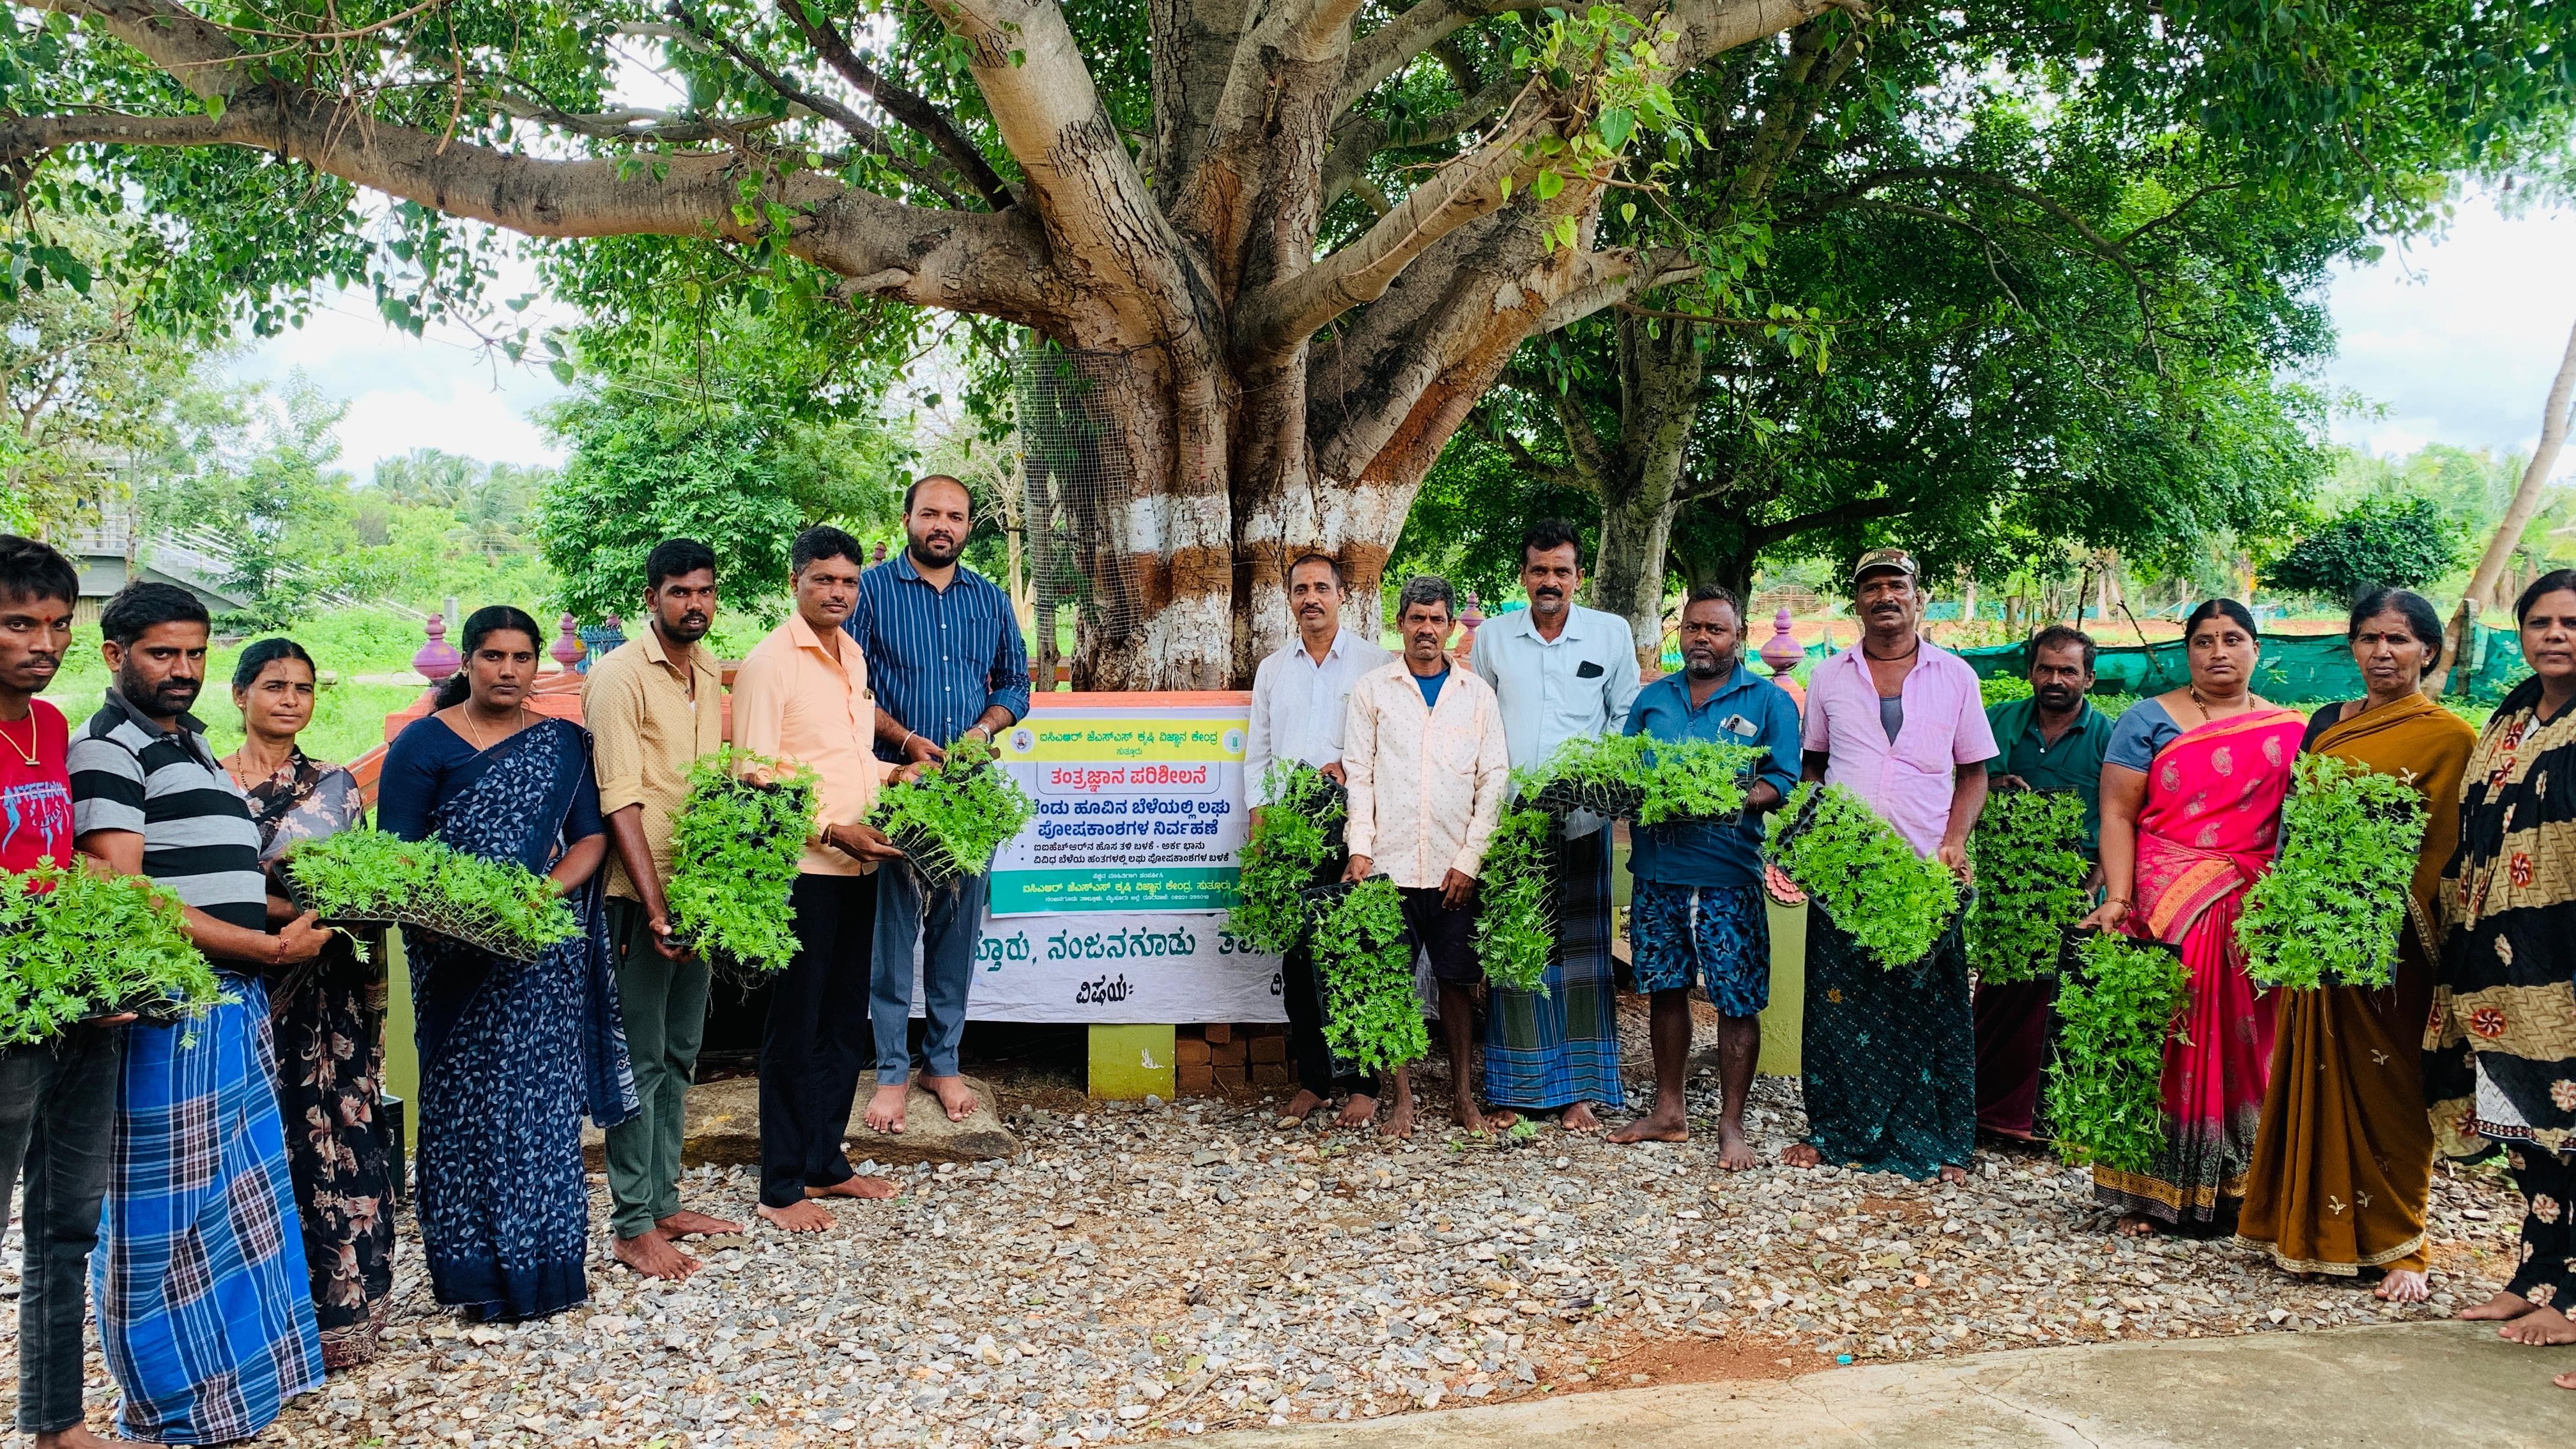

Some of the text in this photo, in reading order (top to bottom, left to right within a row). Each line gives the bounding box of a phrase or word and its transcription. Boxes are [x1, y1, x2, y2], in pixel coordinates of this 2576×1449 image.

[1138, 731, 1154, 746] ಕೃಷಿ
[1160, 732, 1186, 747] ವಿಜ್ಞಾನ
[1192, 731, 1218, 745] ಕೇಂದ್ರ
[1051, 765, 1206, 792] ತಂತ್ರಜ್ಞಾನ ಪರಿಶೀಲನೆ
[1075, 799, 1127, 815] ಹೂವಿನ
[1132, 798, 1196, 819] ಬೆಳೆಯಲ್ಲಿ
[1198, 799, 1230, 817] ಲಘು
[1038, 819, 1218, 839] ಪೋಷಕಾಂಶಗಳ ನಿರ್ವಹಣೆ
[1096, 841, 1117, 850] ಹೊಸ
[1120, 842, 1131, 850] ತಳಿ
[1134, 841, 1154, 850] ಬಳಕೆ
[1162, 841, 1181, 850] ಅರ್ಕ
[1183, 841, 1205, 851] ಭಾನು
[1034, 855, 1056, 865] ವಿವಿಧ
[1059, 855, 1085, 863] ಬೆಳೆಯ
[1087, 854, 1127, 866] ಹಂತಗಳಲ್ಲಿ
[1148, 854, 1207, 864] ಪೋಷಕಾಂಶಗಳ
[1209, 853, 1229, 862] ಬಳಕೆ
[1048, 926, 1196, 960] ನಂಜನಗೂಡು
